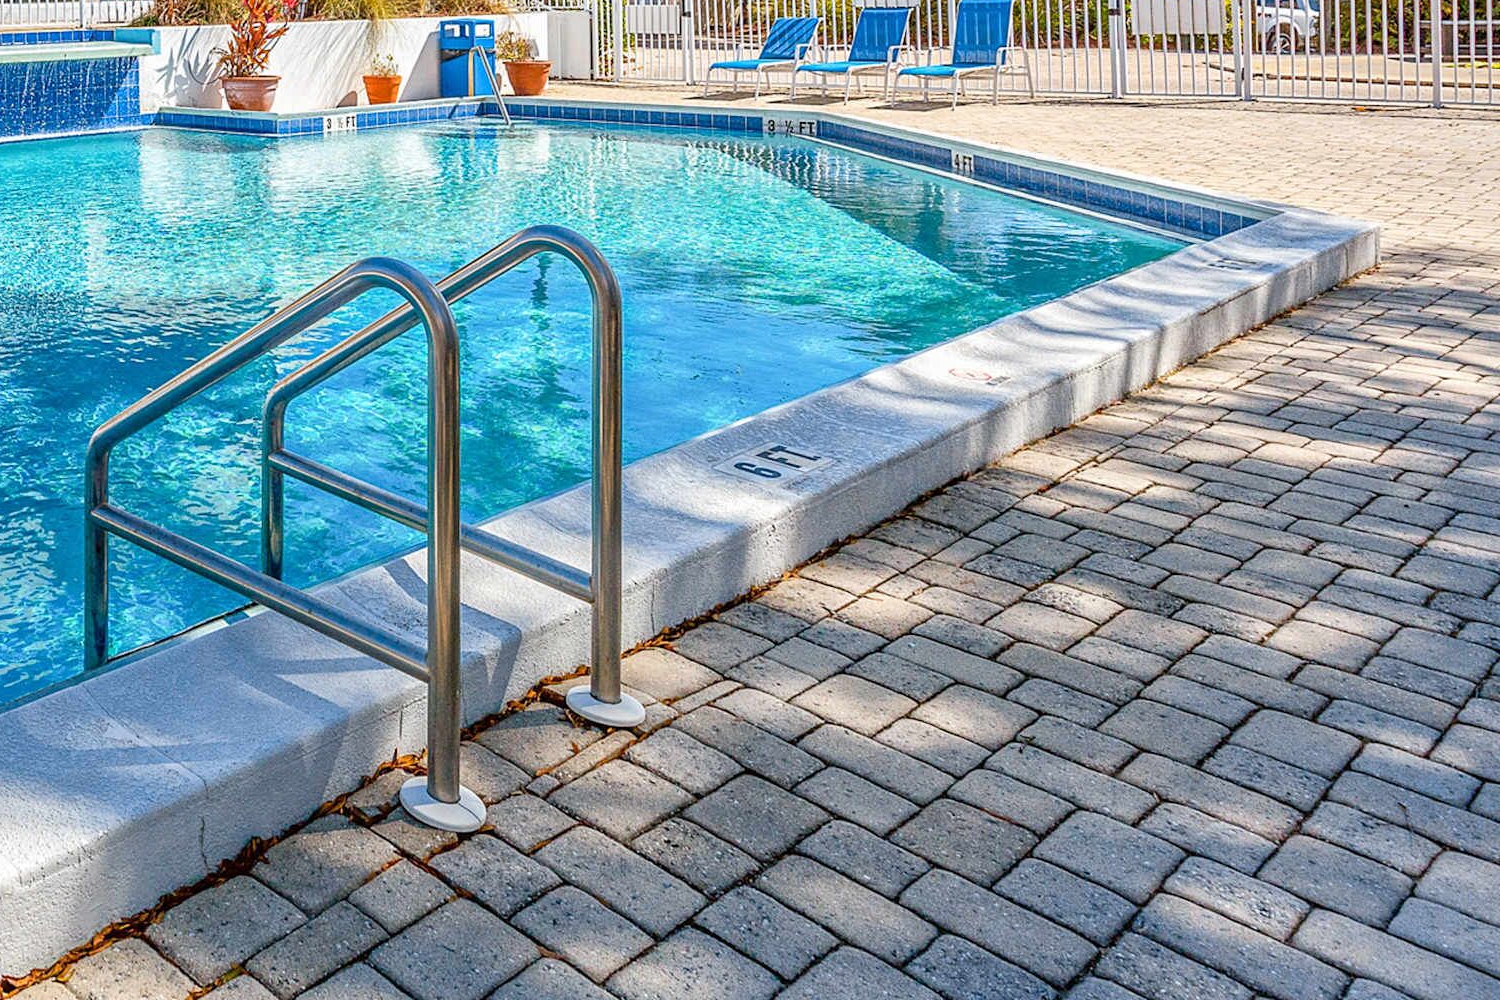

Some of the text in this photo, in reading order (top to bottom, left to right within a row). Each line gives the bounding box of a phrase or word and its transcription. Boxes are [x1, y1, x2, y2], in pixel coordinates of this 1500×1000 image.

[327, 118, 332, 129] 3
[346, 116, 356, 128] FT
[768, 119, 775, 131] 3
[733, 462, 782, 478] 6
